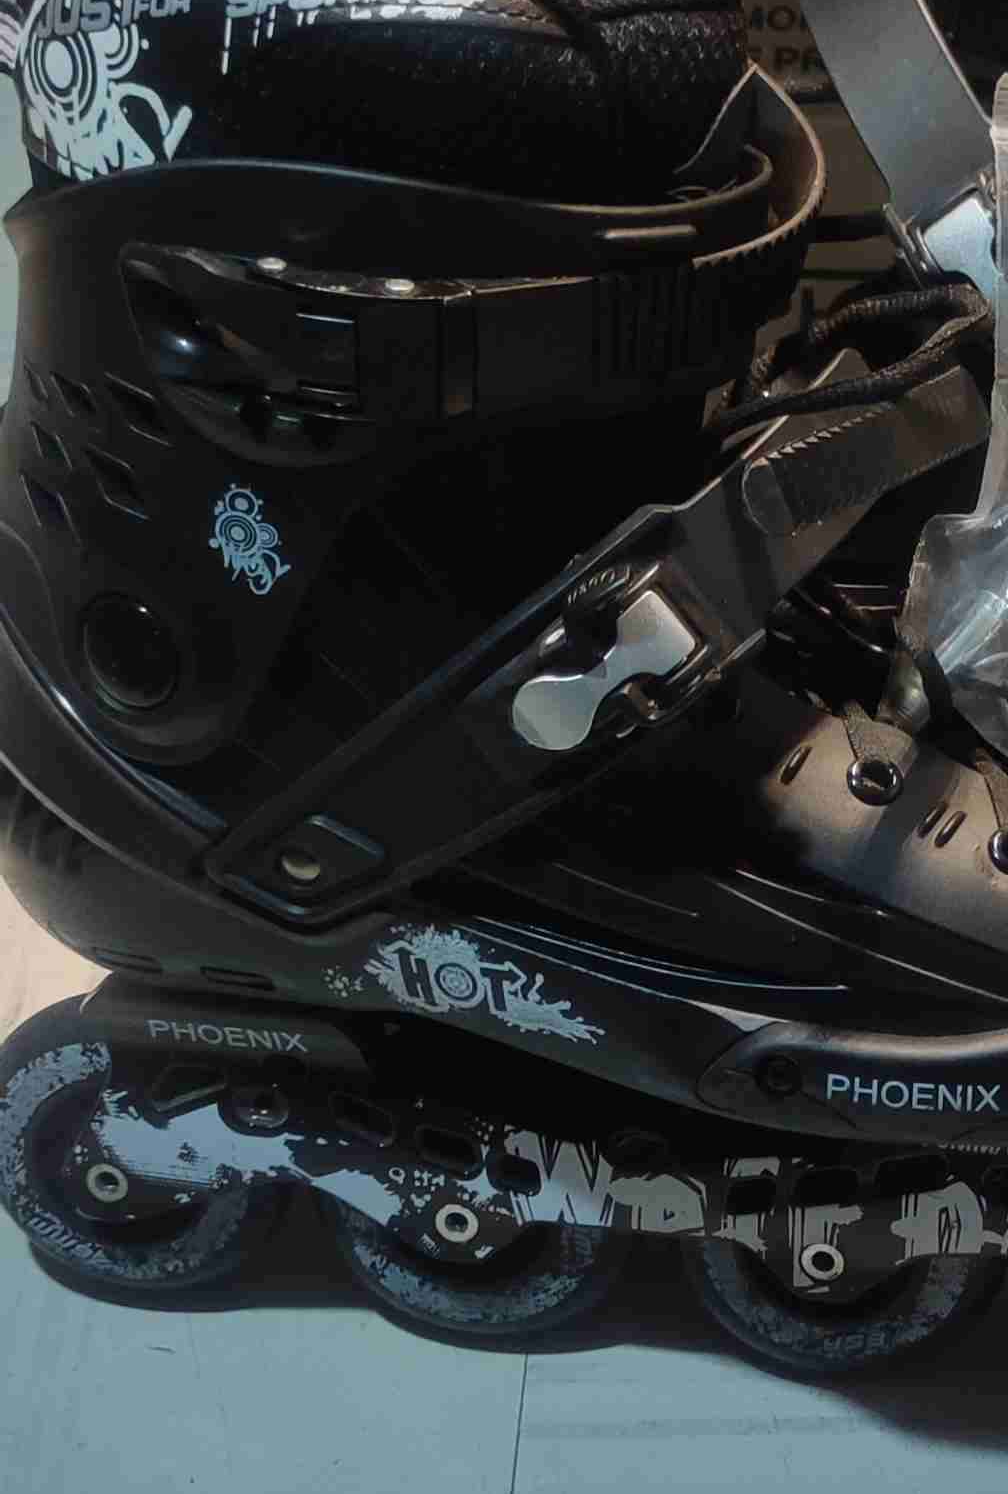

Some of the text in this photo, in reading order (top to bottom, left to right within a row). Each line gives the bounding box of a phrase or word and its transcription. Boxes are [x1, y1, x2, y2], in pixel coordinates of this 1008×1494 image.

[398, 953, 522, 1015] HOT
[147, 1018, 309, 1053] PHOENIX
[826, 1073, 1002, 1113] PHOENIX
